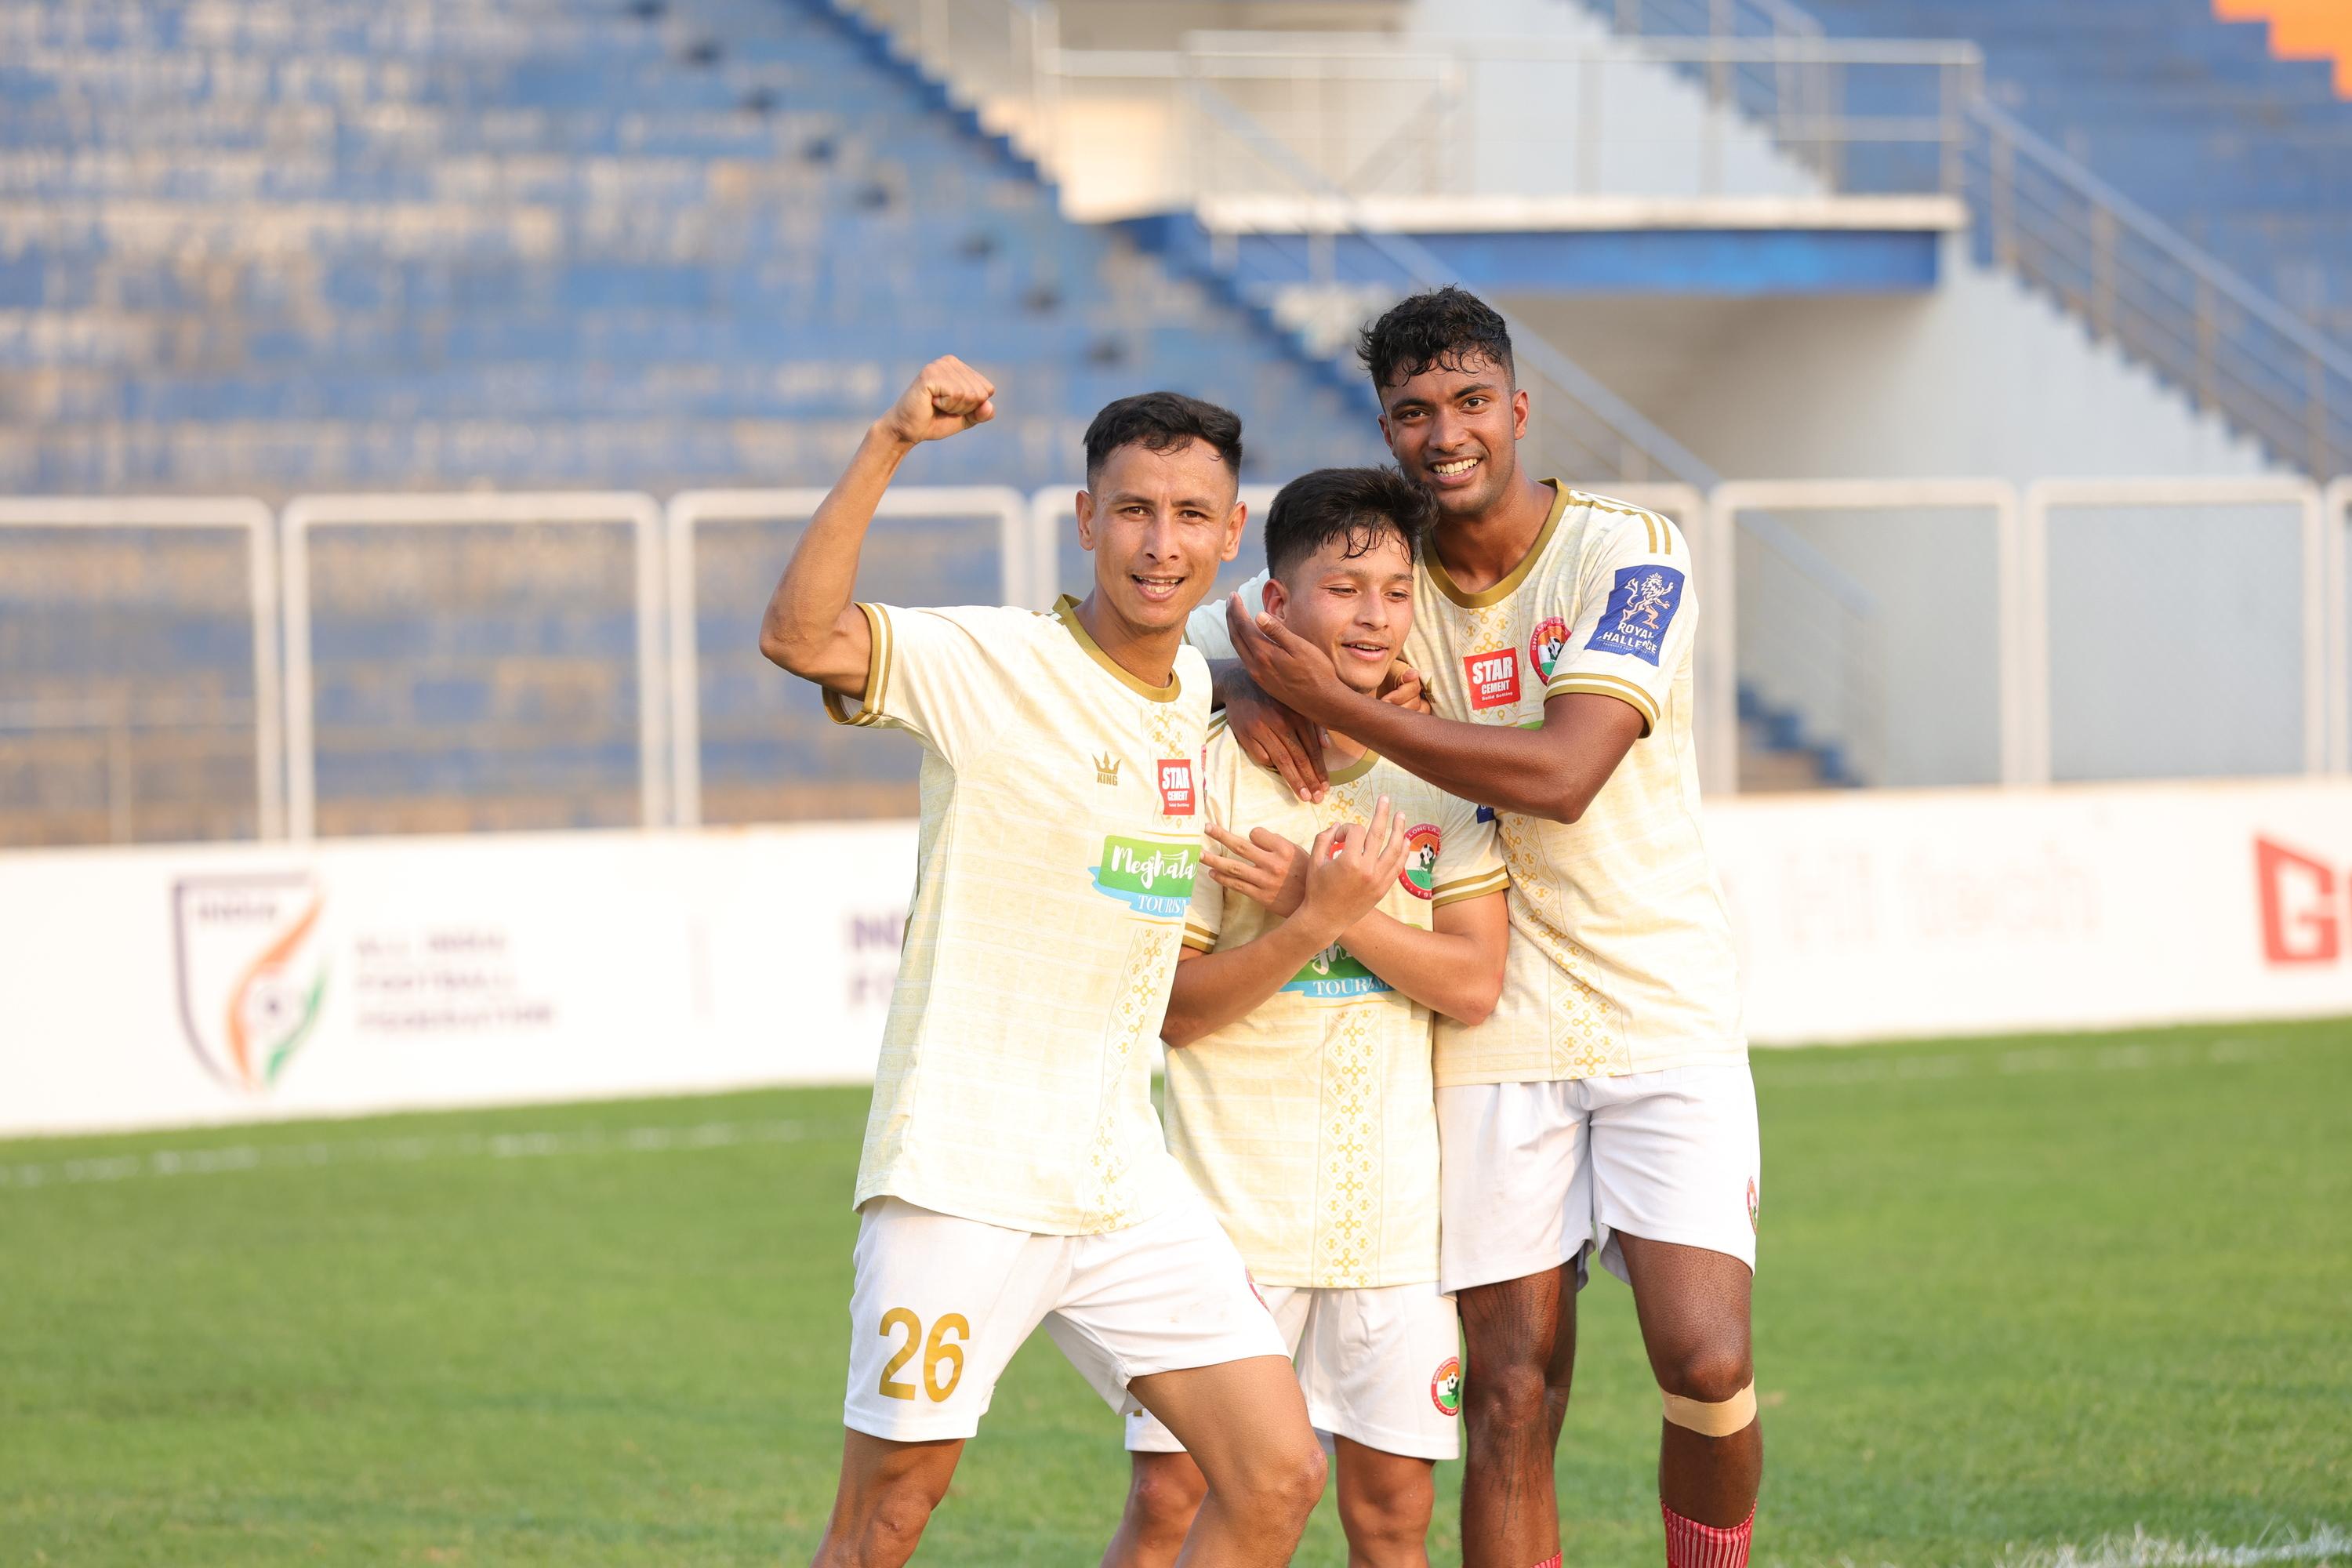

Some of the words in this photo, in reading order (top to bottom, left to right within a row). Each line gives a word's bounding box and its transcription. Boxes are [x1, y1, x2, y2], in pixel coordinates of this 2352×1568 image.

[1617, 622, 1654, 639] ROYAL
[1472, 656, 1513, 684] STAR
[1481, 680, 1510, 695] CEMENT
[1097, 772, 1118, 786] KING
[1162, 767, 1190, 789] STAR
[1167, 790, 1189, 801] CEMENT
[1111, 844, 1198, 890] Meghala
[879, 1307, 970, 1403] 26
